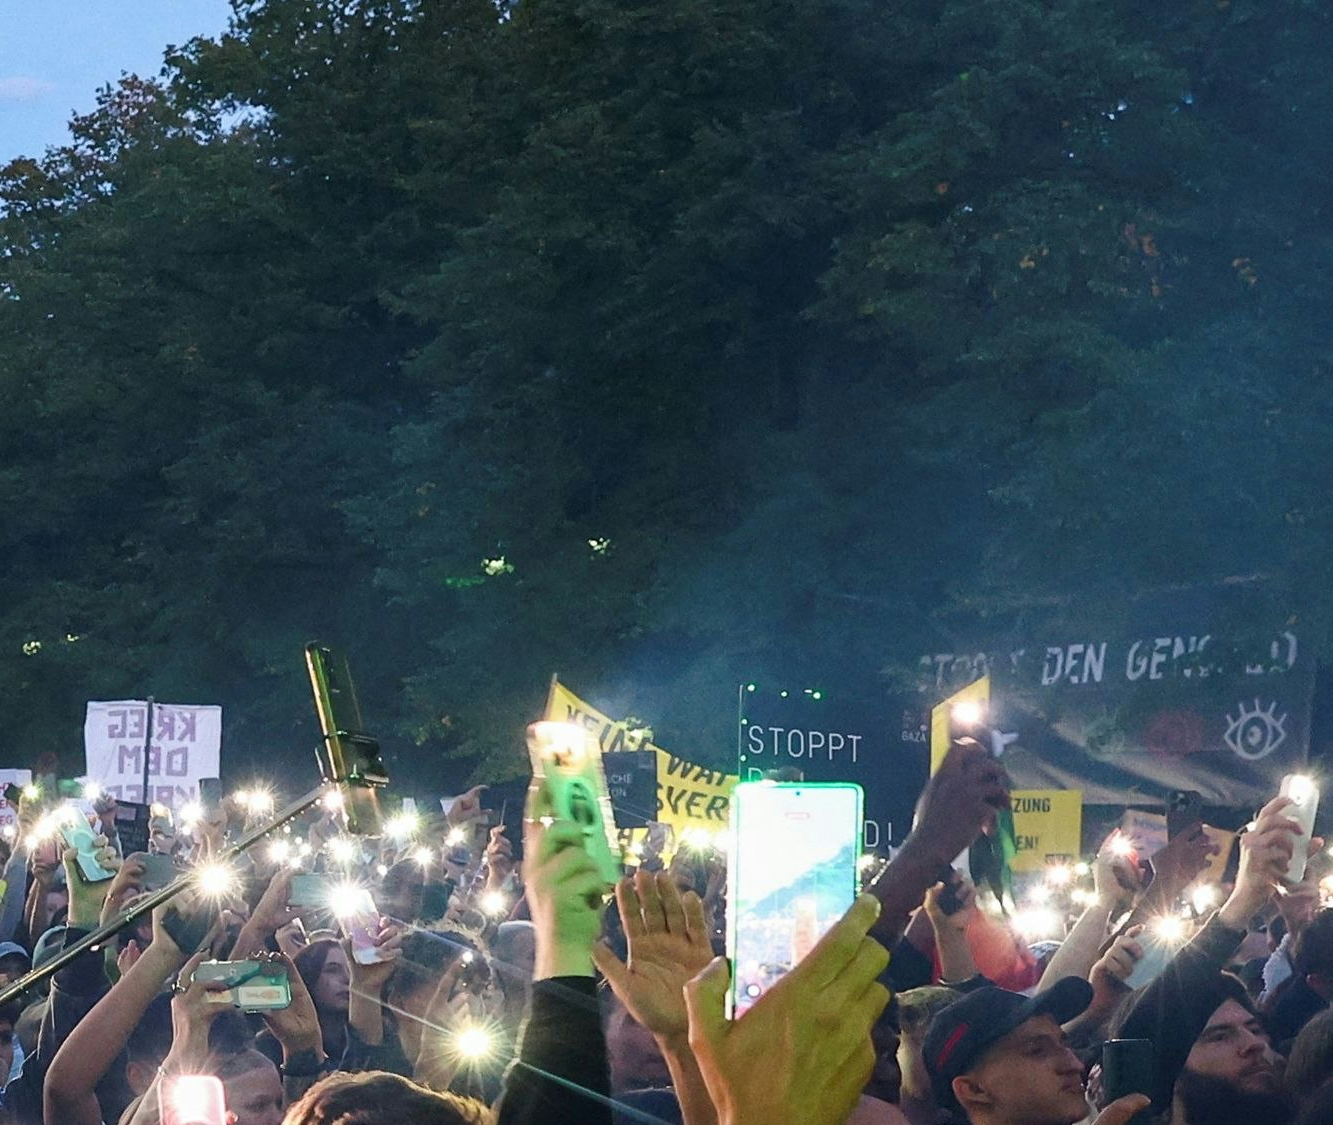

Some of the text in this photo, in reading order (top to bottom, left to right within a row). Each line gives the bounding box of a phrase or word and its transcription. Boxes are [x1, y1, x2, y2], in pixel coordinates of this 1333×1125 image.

[1041, 642, 1108, 686] DEN
[748, 725, 862, 763] STOPPT
[1013, 797, 1051, 813] ZUNG
[864, 819, 893, 849] D!
[1015, 835, 1039, 850] EN!
